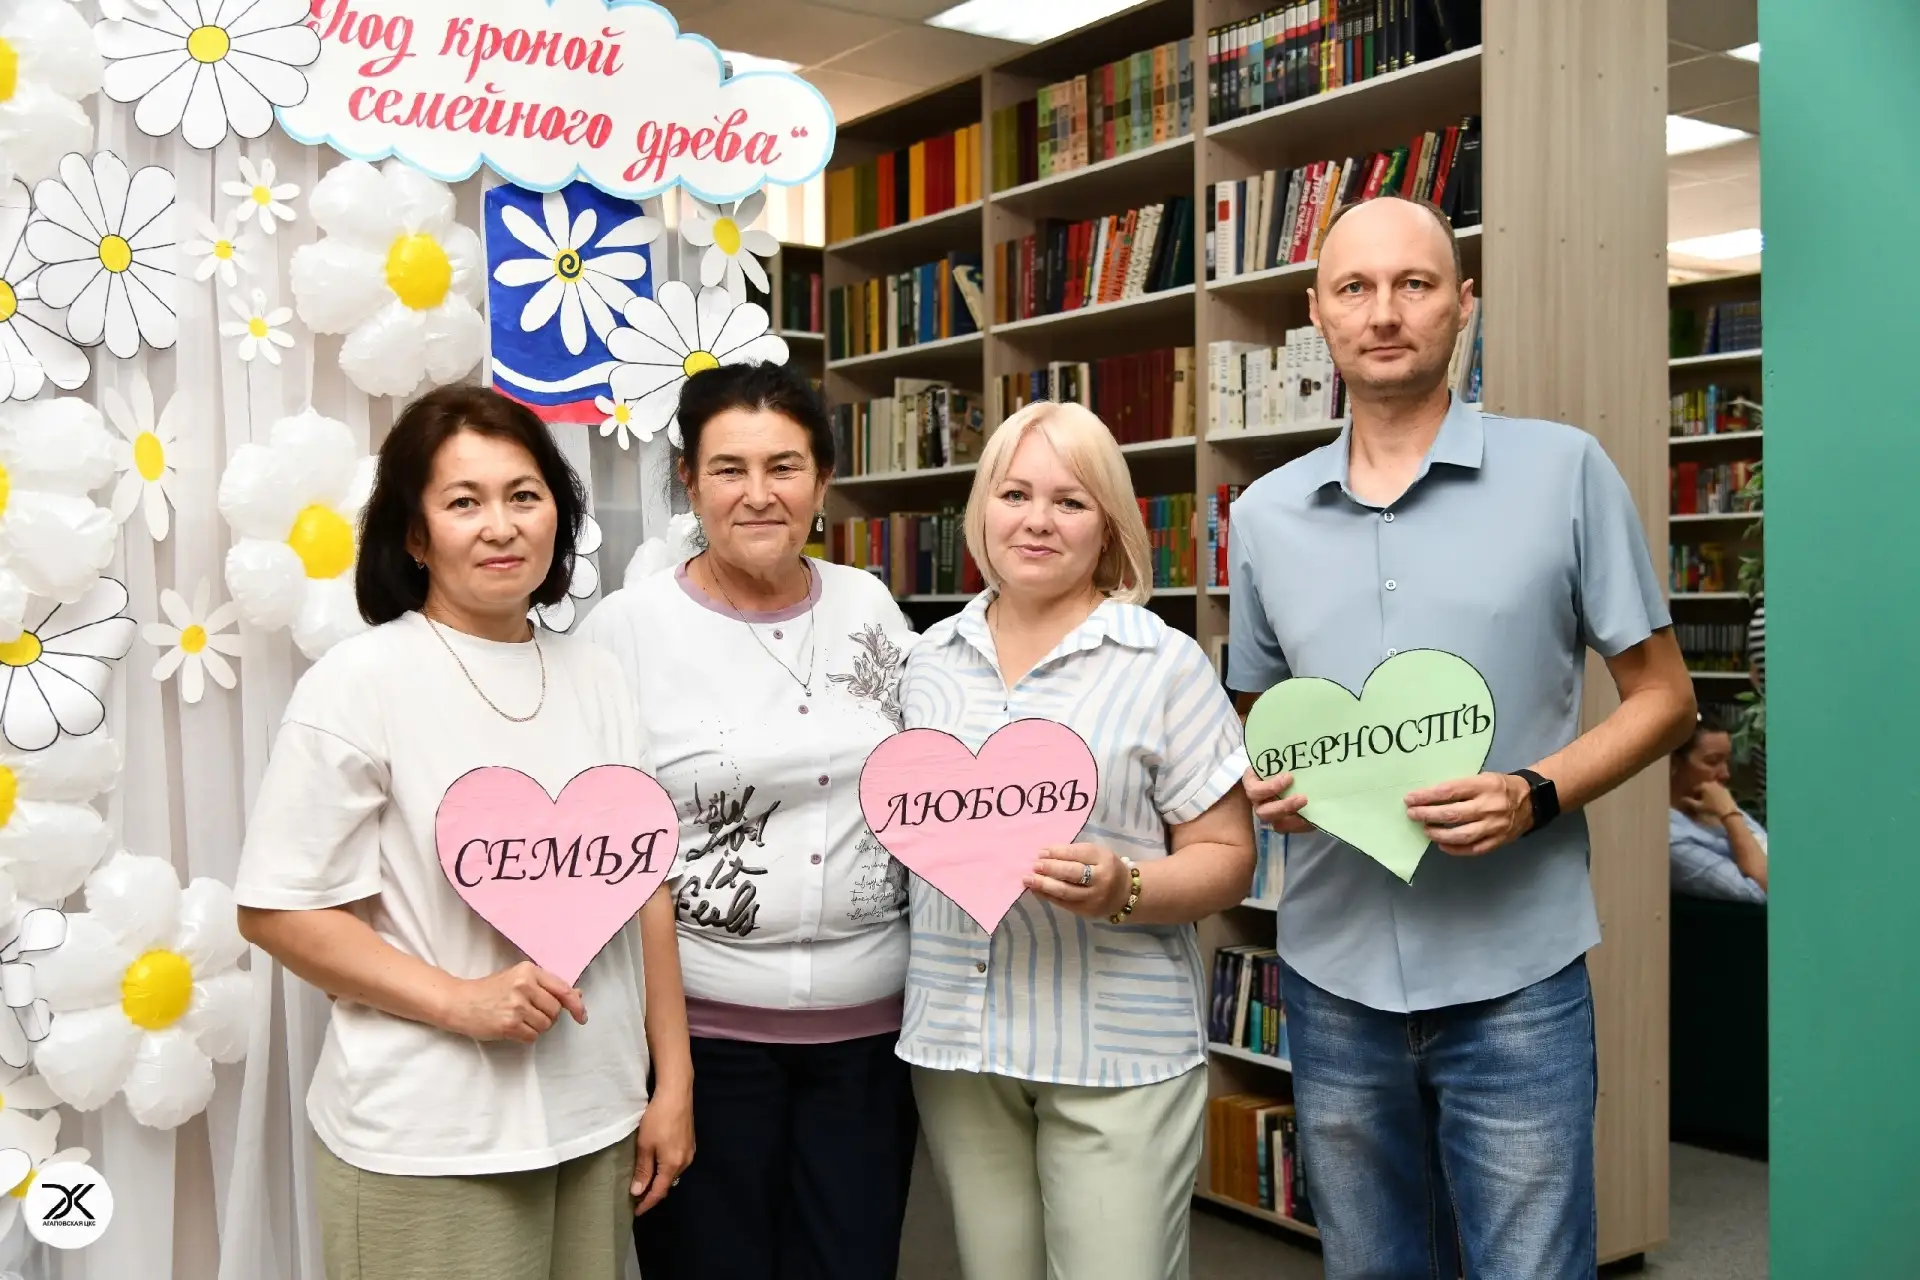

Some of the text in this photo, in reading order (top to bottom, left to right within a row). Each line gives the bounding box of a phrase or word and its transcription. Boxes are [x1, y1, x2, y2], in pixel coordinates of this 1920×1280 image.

[439, 17, 624, 84] кроной
[349, 83, 613, 149] семейного
[1256, 704, 1491, 778] ВЕРНОСТЬ
[875, 780, 1089, 834] ЛЮБОВЬ
[455, 829, 668, 887] СЕМЬЯ
